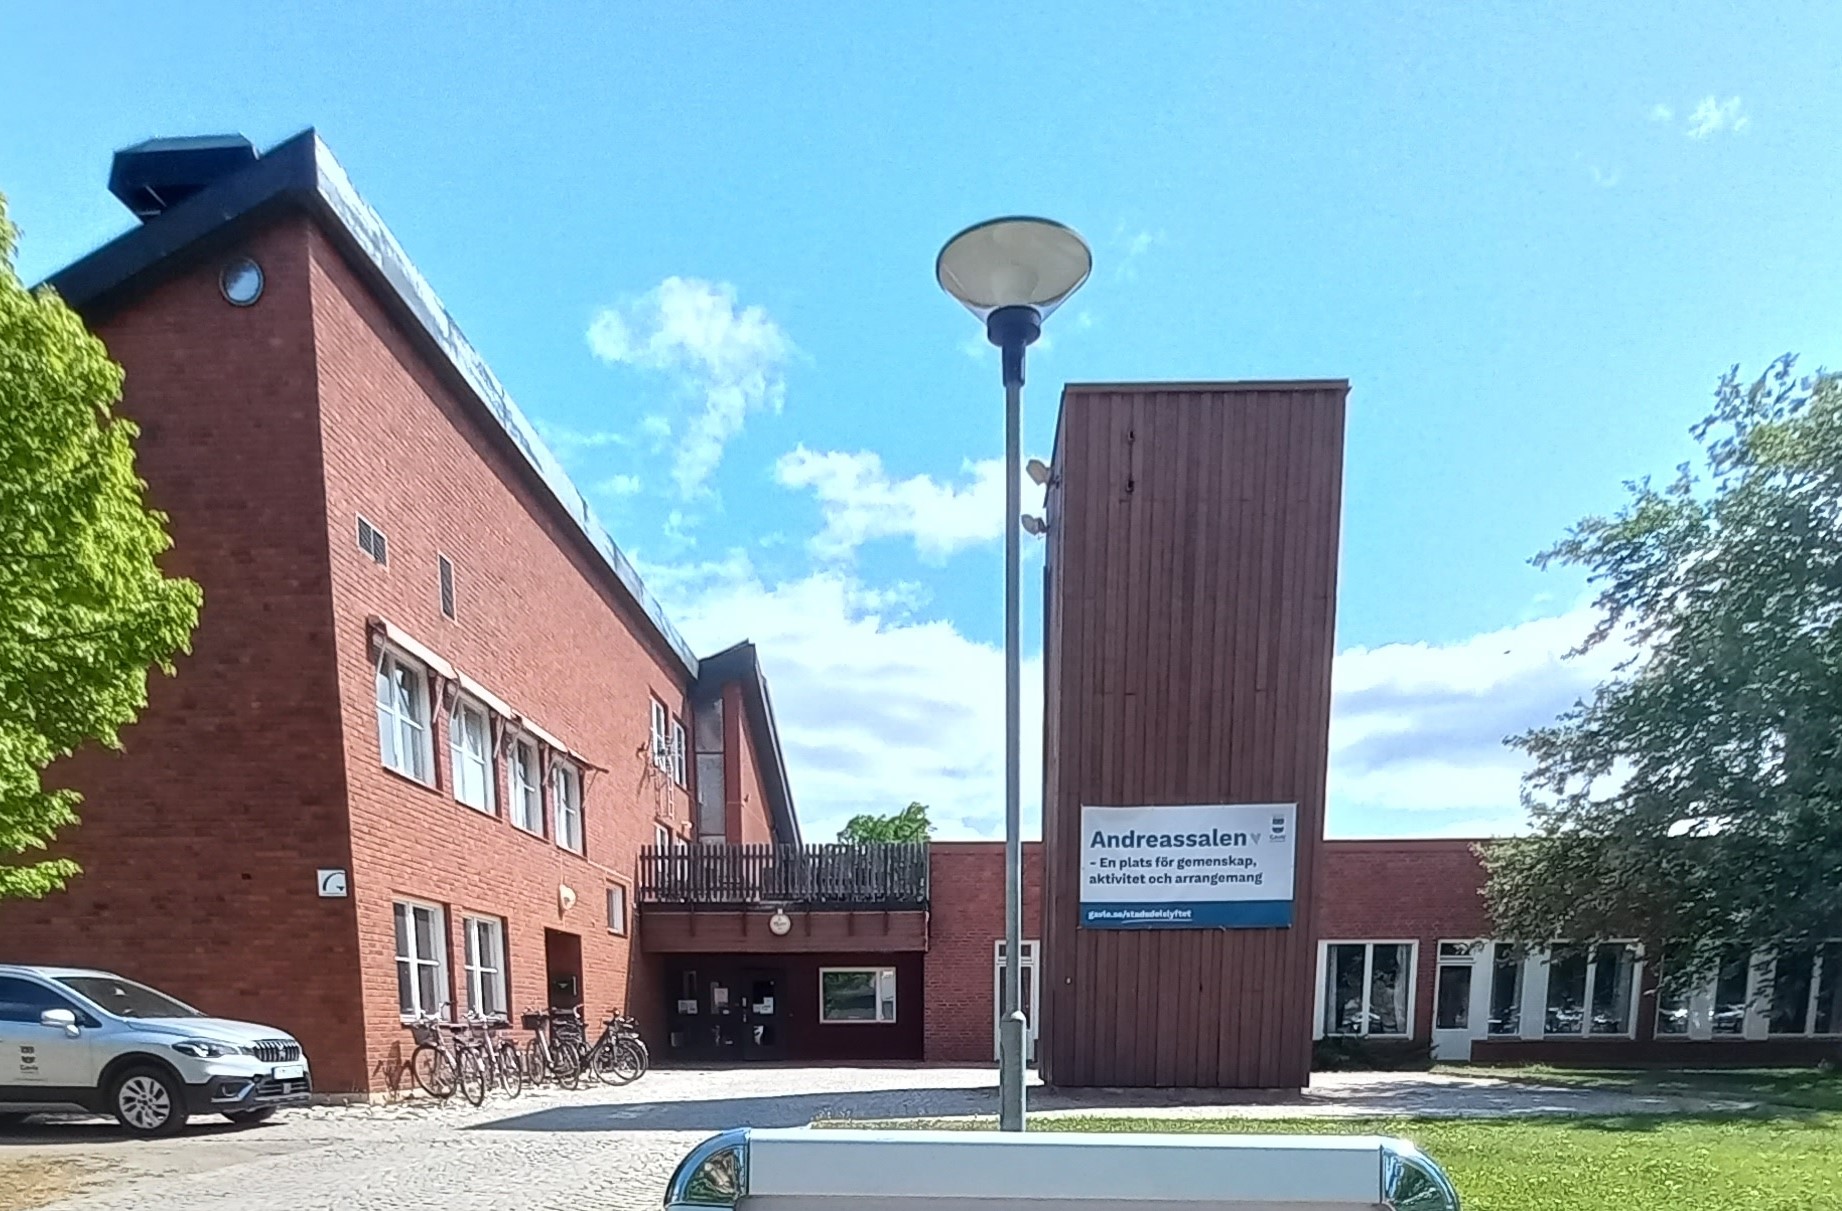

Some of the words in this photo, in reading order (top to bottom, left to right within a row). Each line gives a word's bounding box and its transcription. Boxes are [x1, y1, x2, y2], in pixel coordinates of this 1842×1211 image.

[1090, 828, 1247, 848] Andreassalen
[1100, 857, 1116, 868] En
[1119, 856, 1153, 870] plats
[1155, 856, 1175, 868] för
[1177, 855, 1257, 870] gemenskap,
[1089, 872, 1146, 885] aktivitet
[1148, 871, 1173, 884] och
[1175, 871, 1264, 886] arrangemang
